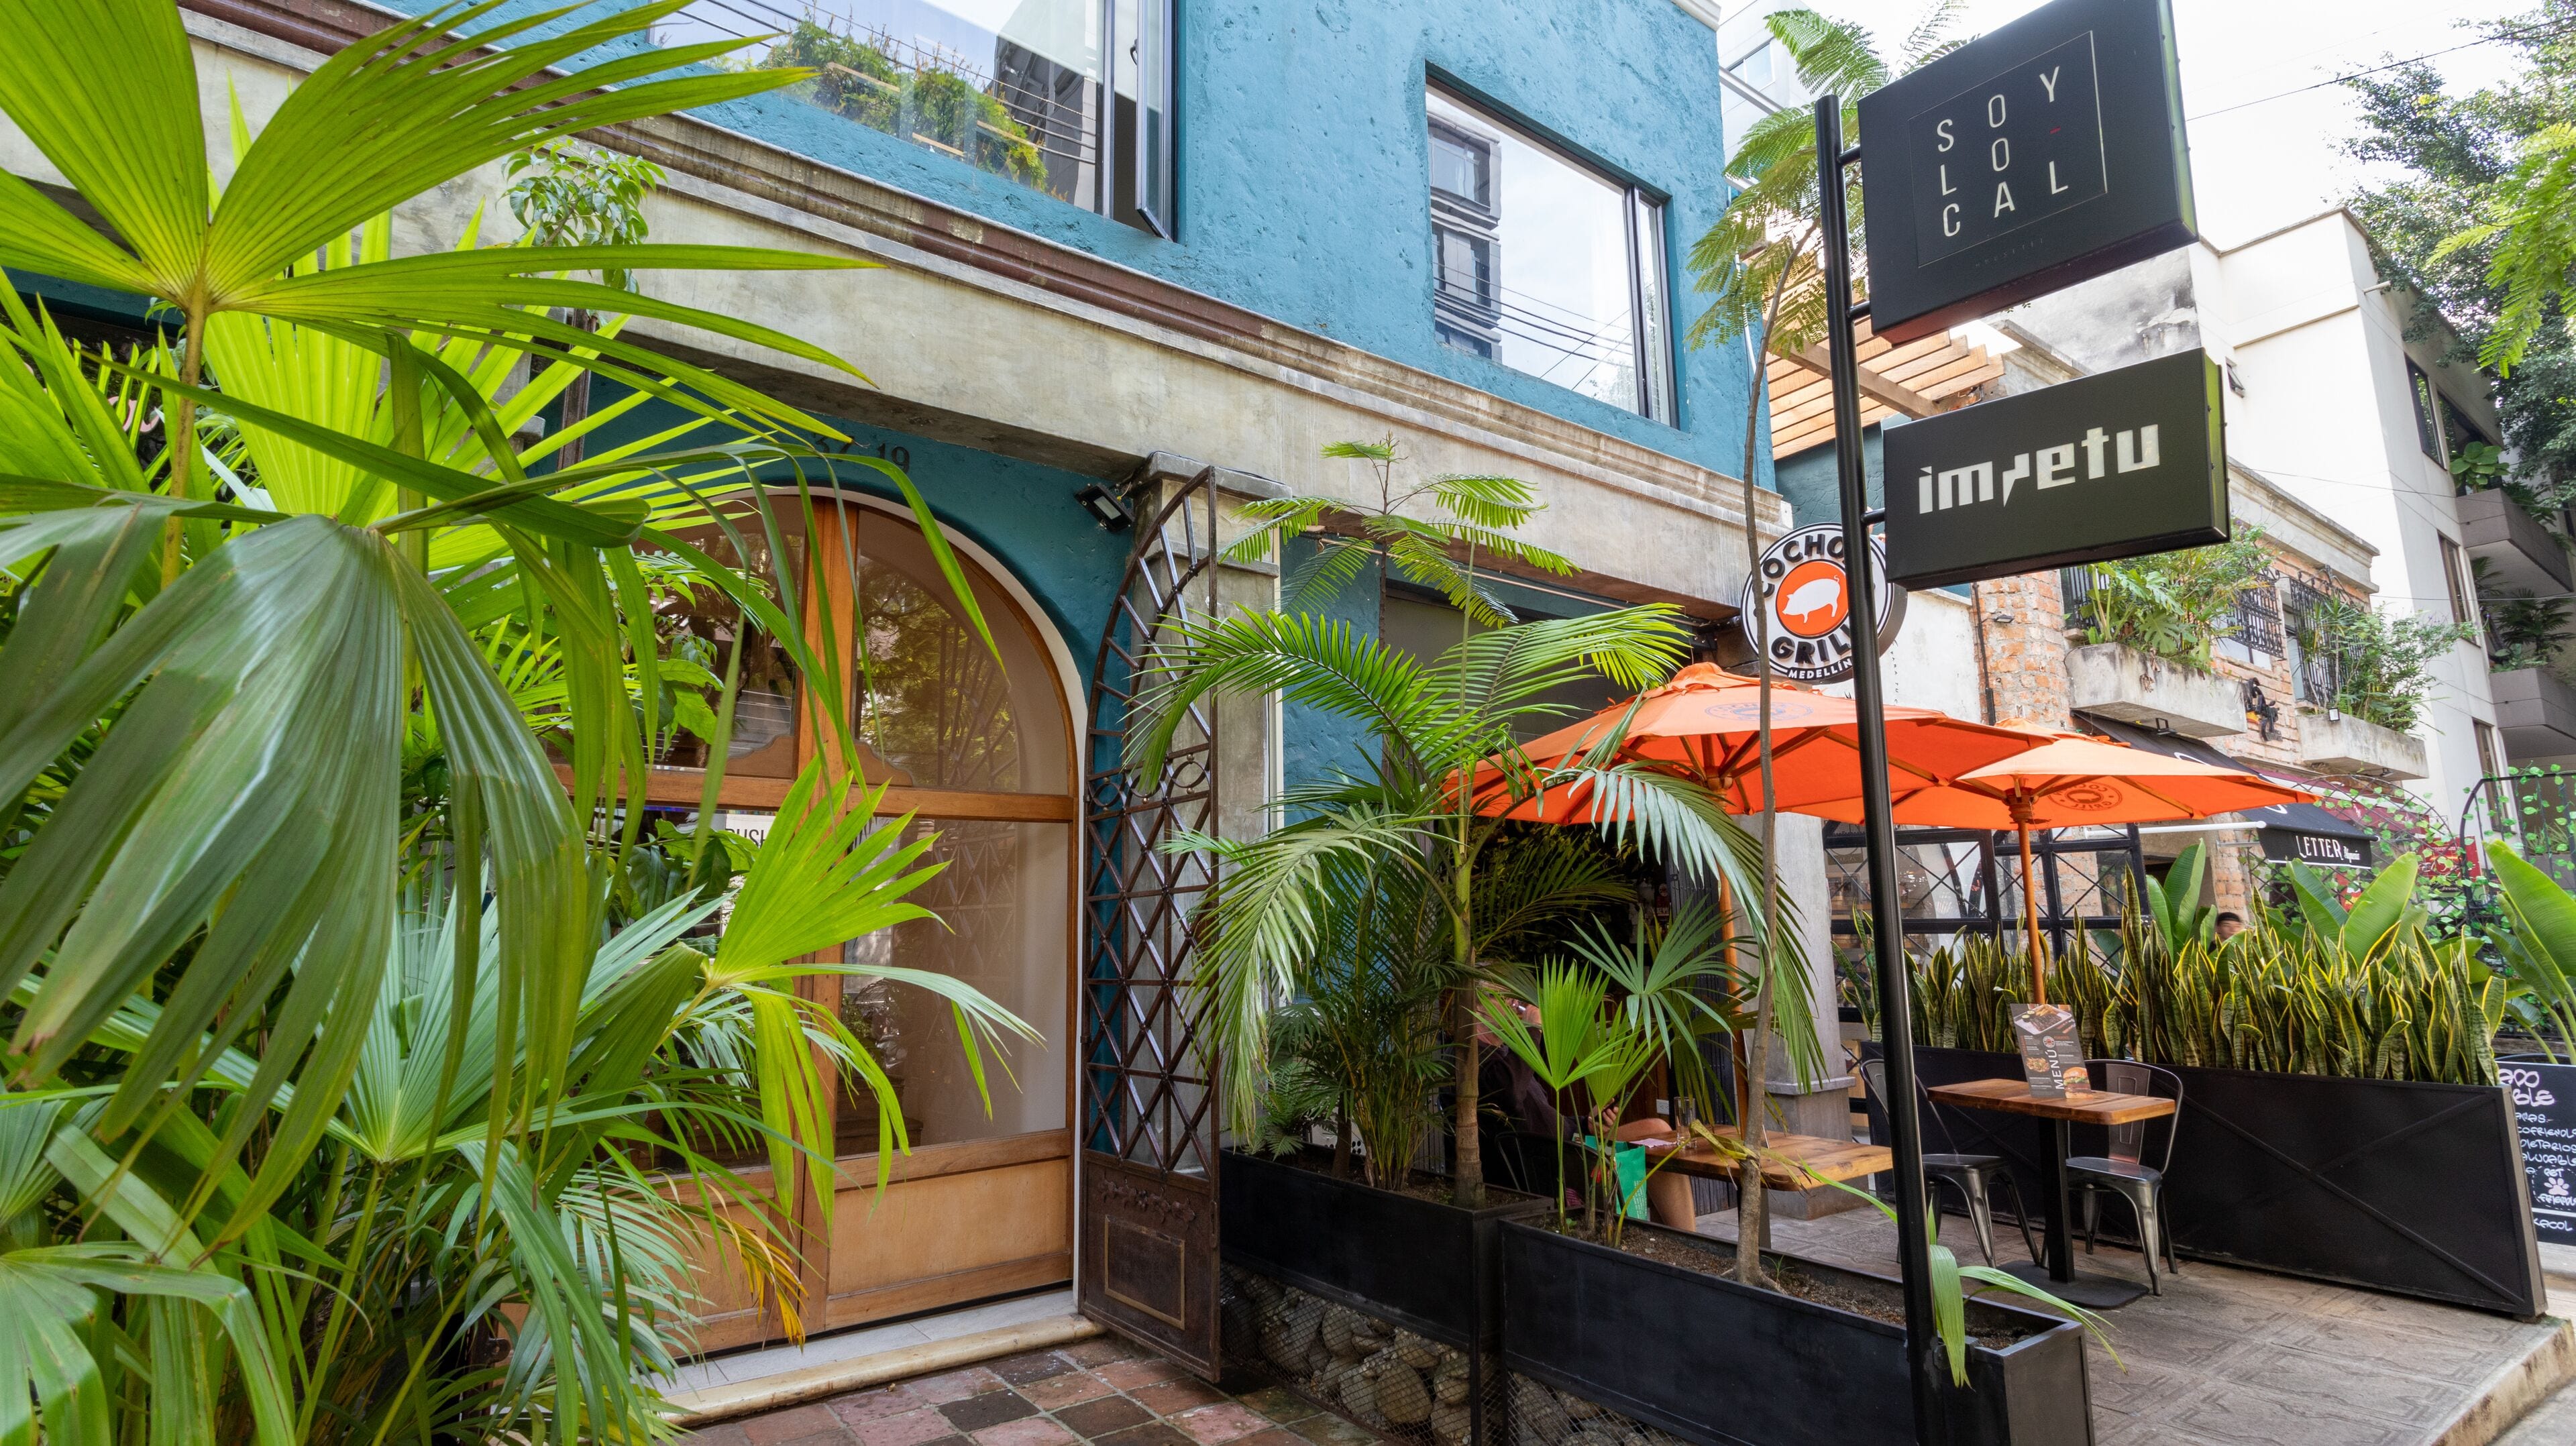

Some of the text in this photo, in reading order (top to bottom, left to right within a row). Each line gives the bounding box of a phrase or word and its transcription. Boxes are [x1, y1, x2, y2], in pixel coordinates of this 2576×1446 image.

[1937, 66, 2059, 152] SOY
[1943, 160, 2068, 237] CAL
[876, 443, 910, 474] 19
[2296, 835, 2344, 860] LETTER
[2045, 1049, 2065, 1090] MENÚ
[2544, 1168, 2565, 1178] PET
